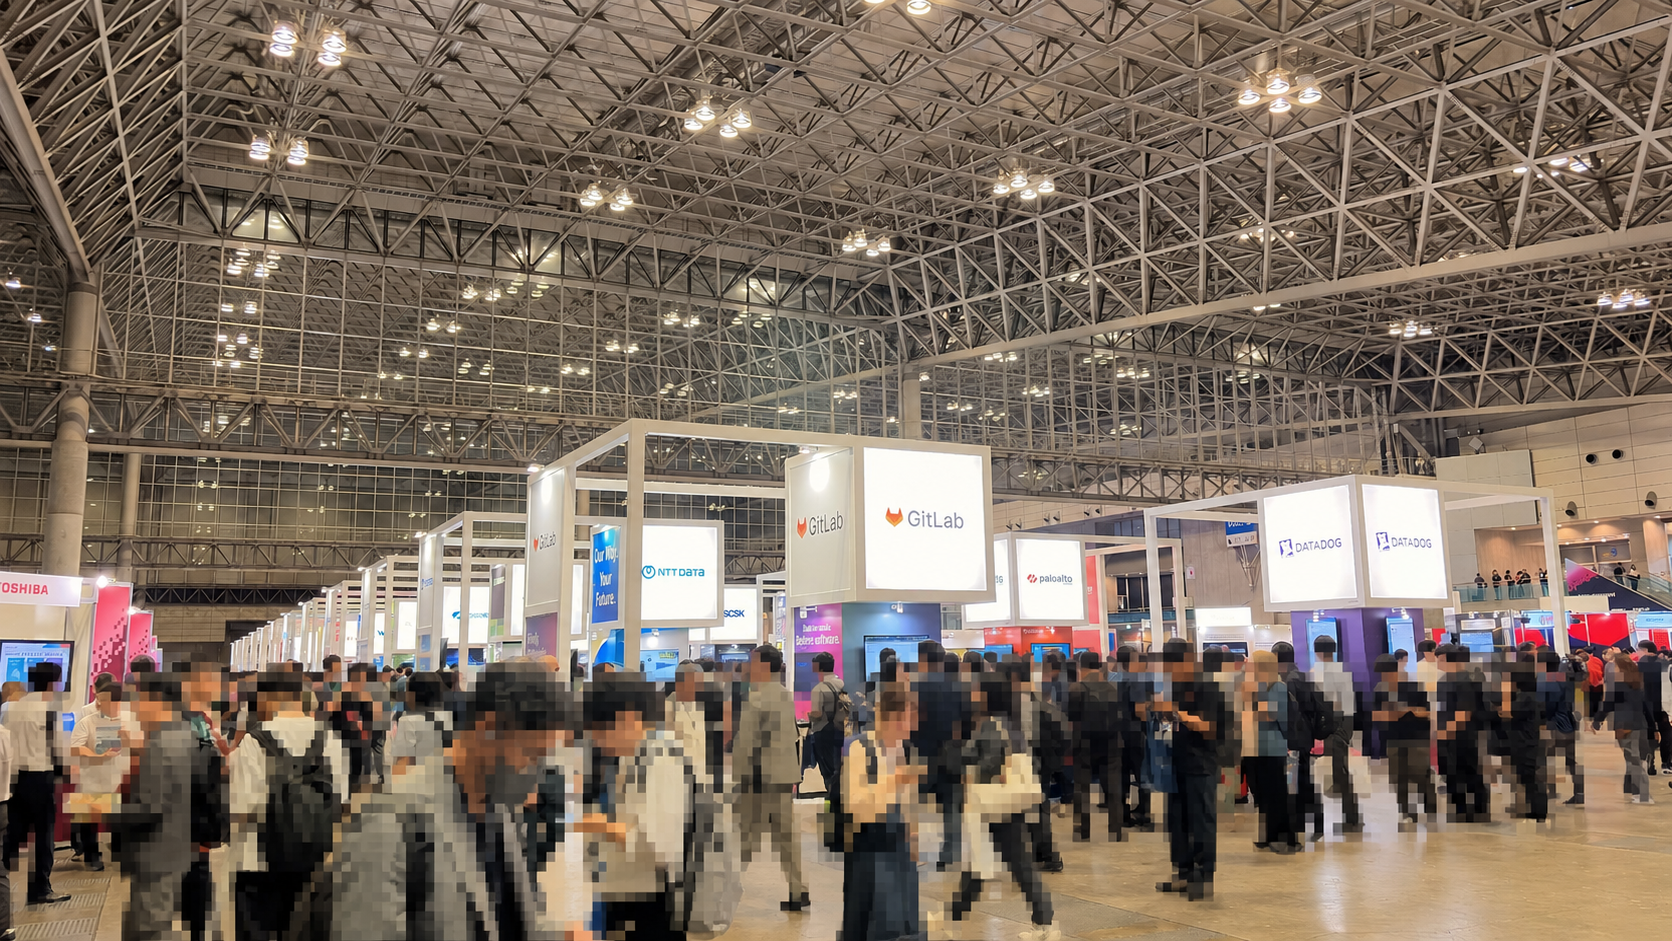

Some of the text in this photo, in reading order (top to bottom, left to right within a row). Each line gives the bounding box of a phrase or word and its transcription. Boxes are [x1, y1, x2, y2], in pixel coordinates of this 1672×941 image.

[809, 511, 844, 536] GitLab
[908, 510, 964, 529] GitLab
[1295, 538, 1342, 553] DATADOG
[1391, 537, 1432, 548] DATADOG
[594, 549, 604, 563] Our
[600, 571, 612, 586] Your
[658, 568, 677, 577] NTT
[0, 582, 49, 595] OSHIBA
[596, 592, 616, 607] Future.
[723, 609, 745, 618] SCSK
